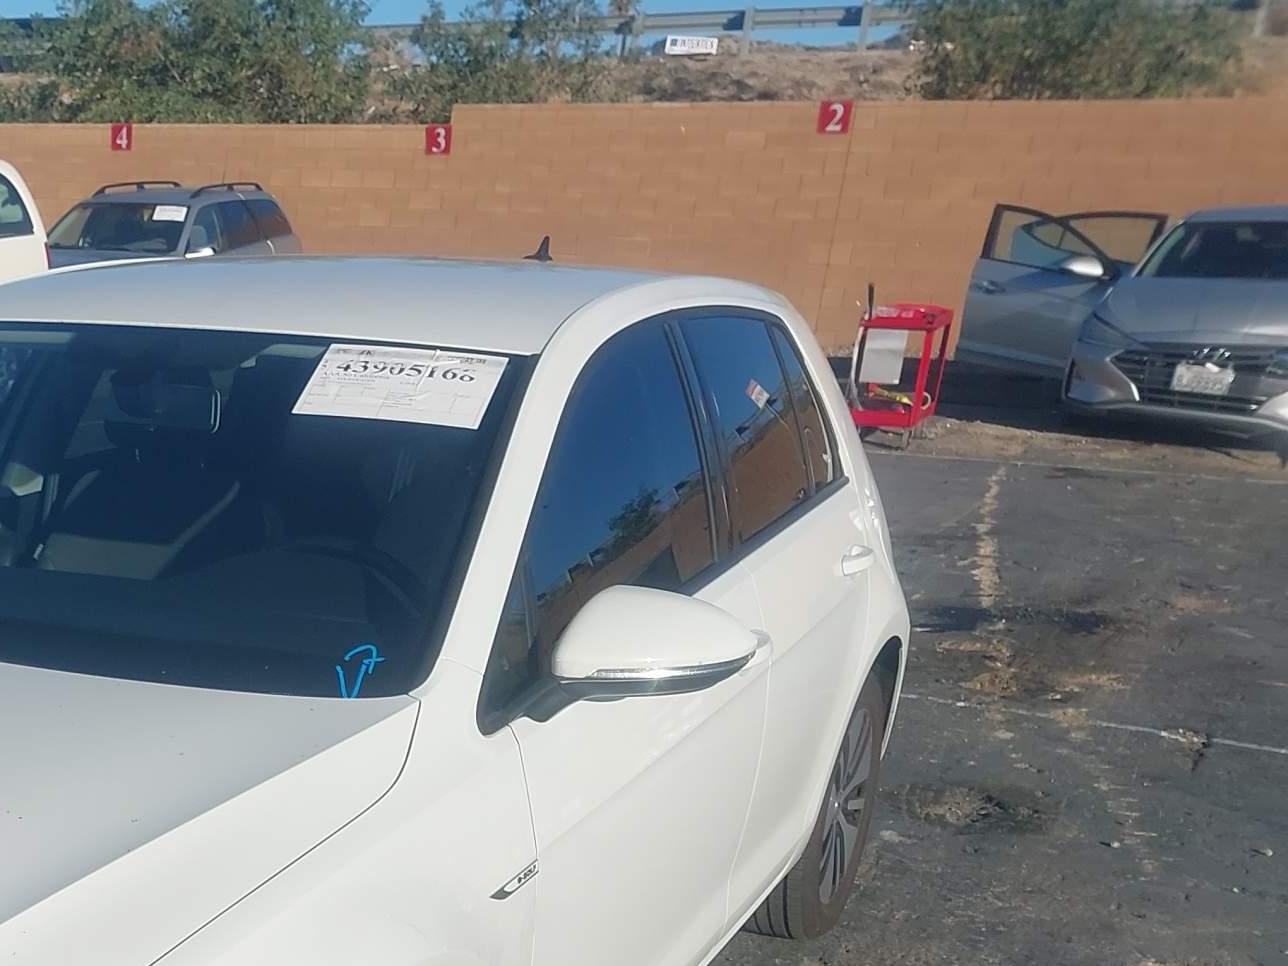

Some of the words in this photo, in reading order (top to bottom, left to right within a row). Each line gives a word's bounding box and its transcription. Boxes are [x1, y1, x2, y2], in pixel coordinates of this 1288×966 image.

[824, 103, 845, 132] 2
[115, 125, 129, 149] 4
[431, 127, 447, 153] 3
